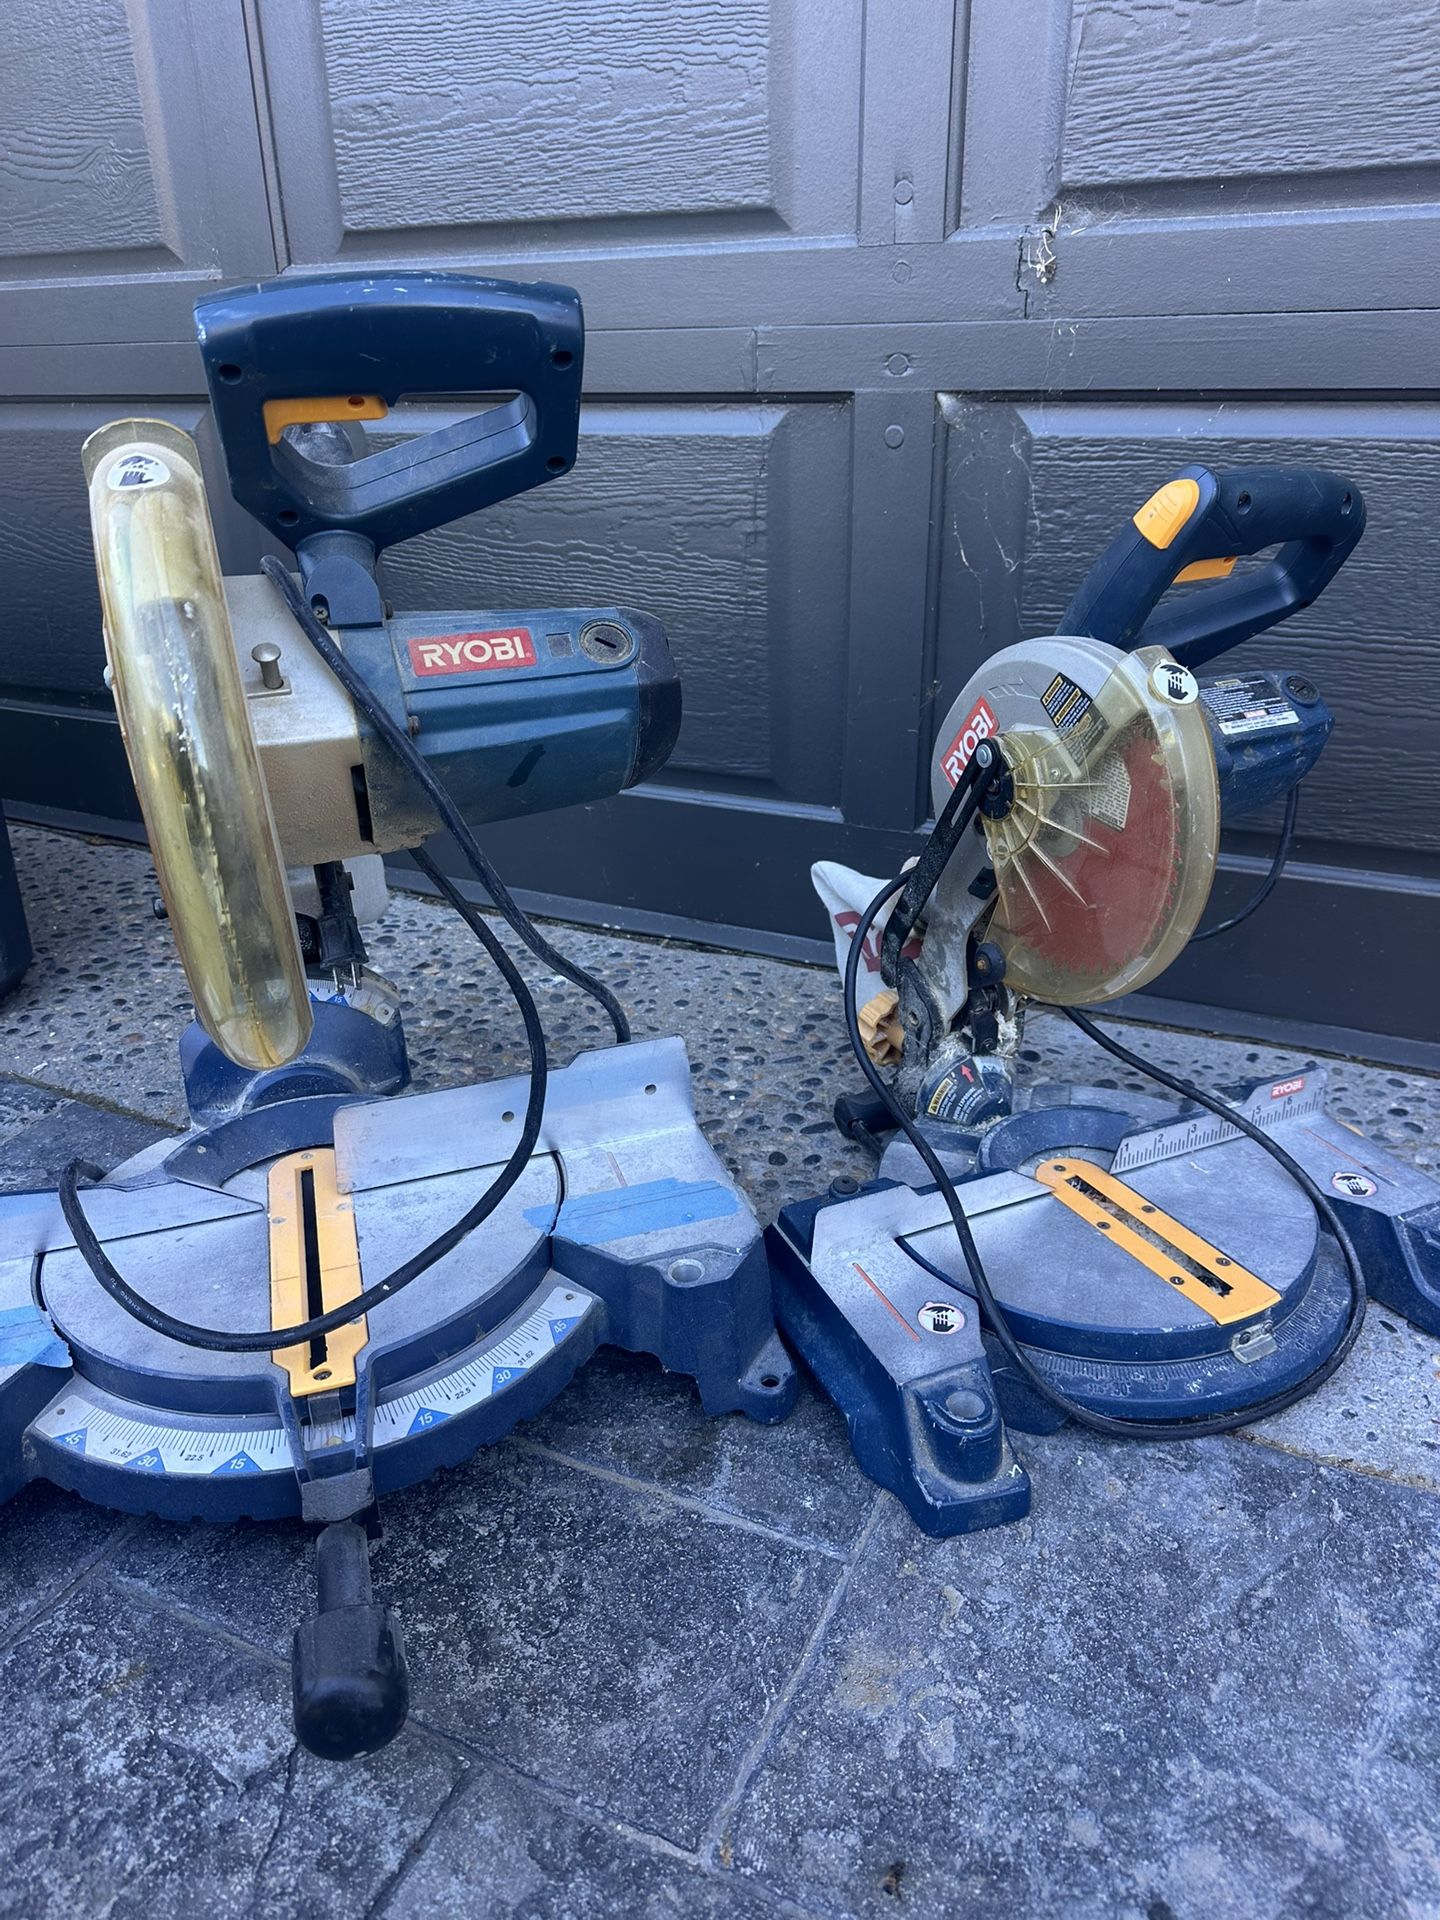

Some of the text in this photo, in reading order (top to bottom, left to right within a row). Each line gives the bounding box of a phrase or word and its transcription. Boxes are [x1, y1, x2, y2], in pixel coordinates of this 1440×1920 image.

[418, 636, 525, 668] RYOBI
[945, 707, 994, 783] RYOBI
[933, 1079, 952, 1107] WARNING
[1271, 1079, 1303, 1097] RYOBI
[1158, 1134, 1164, 1143] 2
[1191, 1124, 1197, 1133] 3
[1256, 1105, 1262, 1114] 5
[1287, 1096, 1293, 1105] 6
[553, 1320, 568, 1335] 45
[517, 1349, 535, 1366] 31.62
[495, 1370, 512, 1384] 30
[454, 1387, 472, 1400] 22.5
[417, 1412, 433, 1426] 15
[64, 1432, 81, 1446] 45
[110, 1446, 132, 1459] 31.62
[184, 1453, 204, 1462] 22.5
[137, 1455, 157, 1468] 30
[229, 1458, 246, 1470] 15
